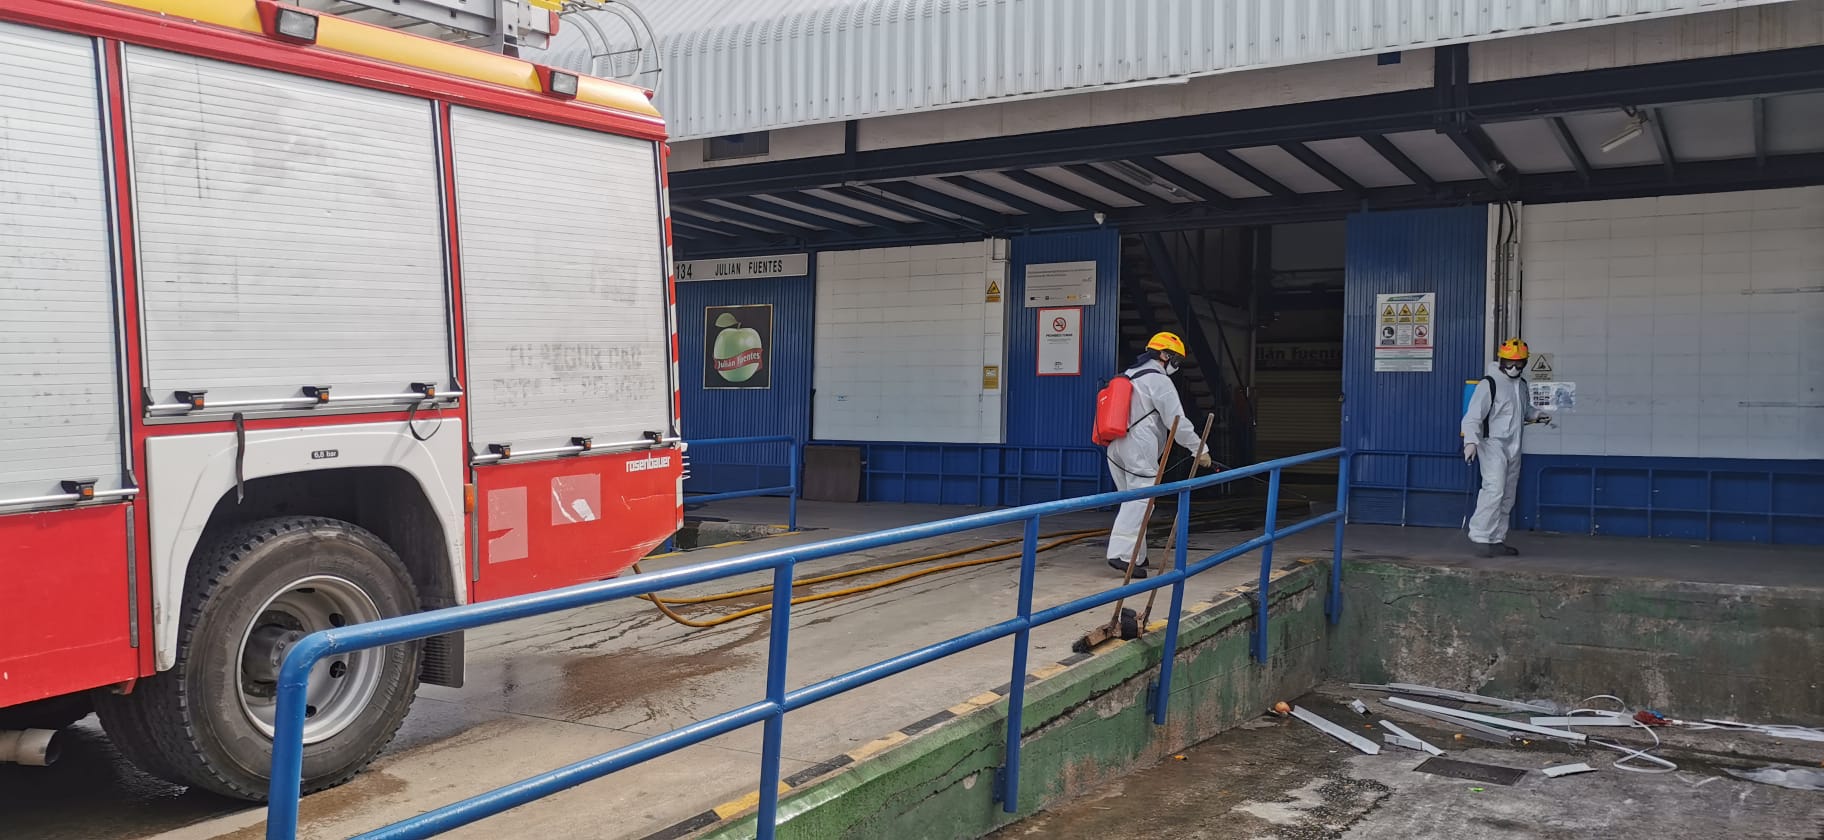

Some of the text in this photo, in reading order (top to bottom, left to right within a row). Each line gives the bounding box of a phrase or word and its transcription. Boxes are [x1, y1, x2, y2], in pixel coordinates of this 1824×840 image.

[676, 260, 783, 279] 134 JULIAN FUENTES
[737, 351, 761, 364] Fuentes
[626, 452, 671, 472] rosenbauer
